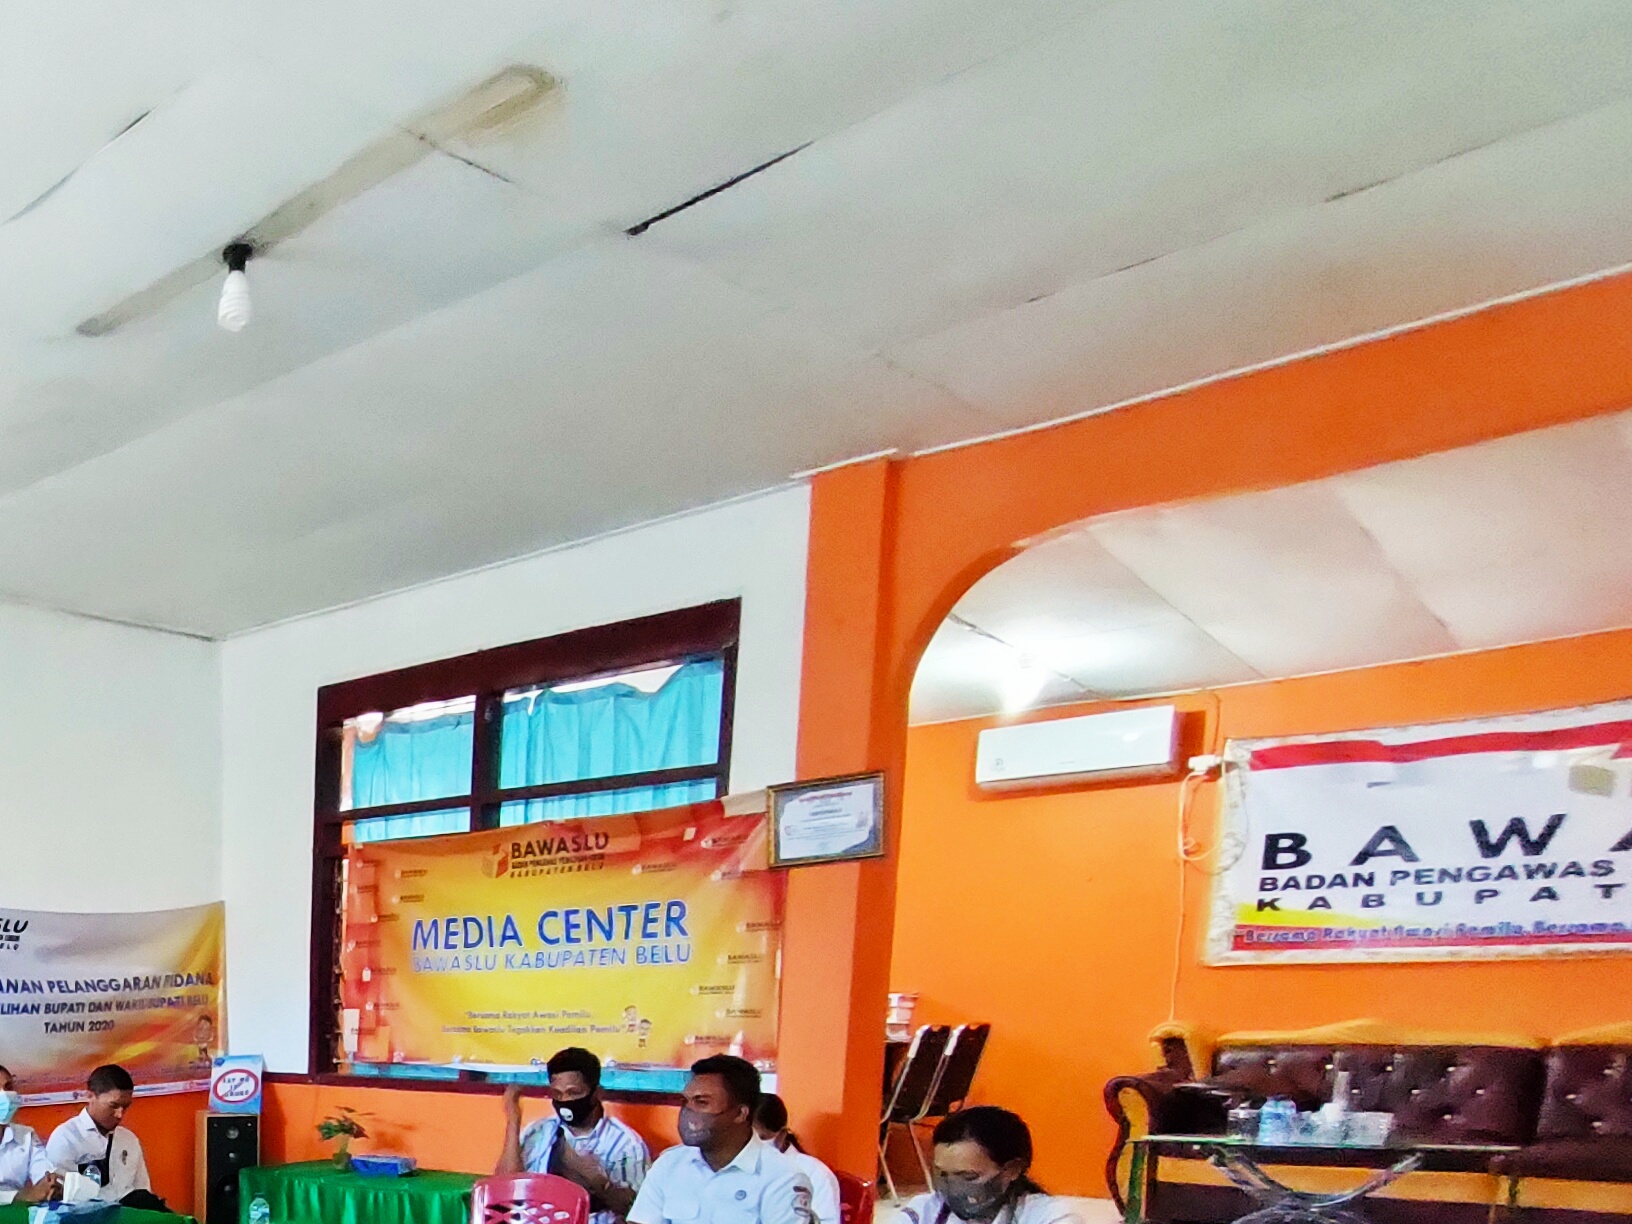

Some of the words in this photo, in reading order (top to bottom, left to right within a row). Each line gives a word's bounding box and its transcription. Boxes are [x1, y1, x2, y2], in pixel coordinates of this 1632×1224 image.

[511, 833, 610, 859] BAWASLU
[1258, 872, 1376, 893] BADAN
[1389, 860, 1616, 886] PENGAWAS
[1255, 882, 1625, 912] KABUPAT
[412, 914, 523, 951] MEDIA
[537, 900, 689, 945] CENTER
[412, 954, 497, 973] BAWASLU
[505, 947, 626, 971] KABUPATEN
[636, 943, 691, 964] BELU
[47, 973, 162, 993] PELANGGARAN
[44, 1001, 86, 1014] BUPATI
[88, 999, 113, 1013] DAN
[44, 1021, 85, 1034] TAHUN
[88, 1019, 114, 1032] 2020
